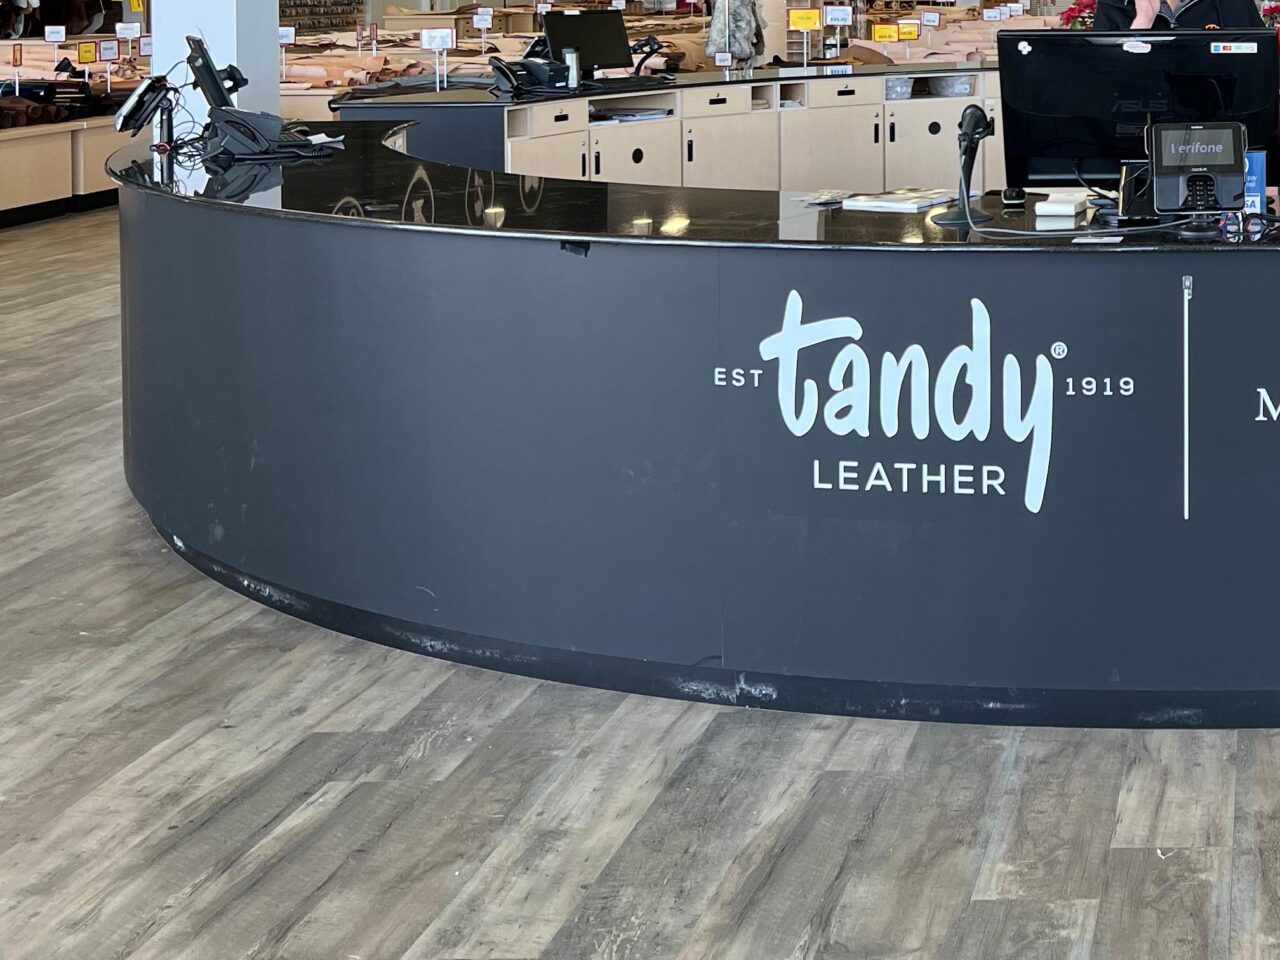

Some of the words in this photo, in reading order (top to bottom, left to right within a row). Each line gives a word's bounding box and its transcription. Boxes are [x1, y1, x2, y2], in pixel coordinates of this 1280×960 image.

[1111, 100, 1168, 113] ASUS
[713, 367, 764, 388] EST
[1065, 376, 1135, 396] 1919
[813, 459, 1007, 496] LEATHER
